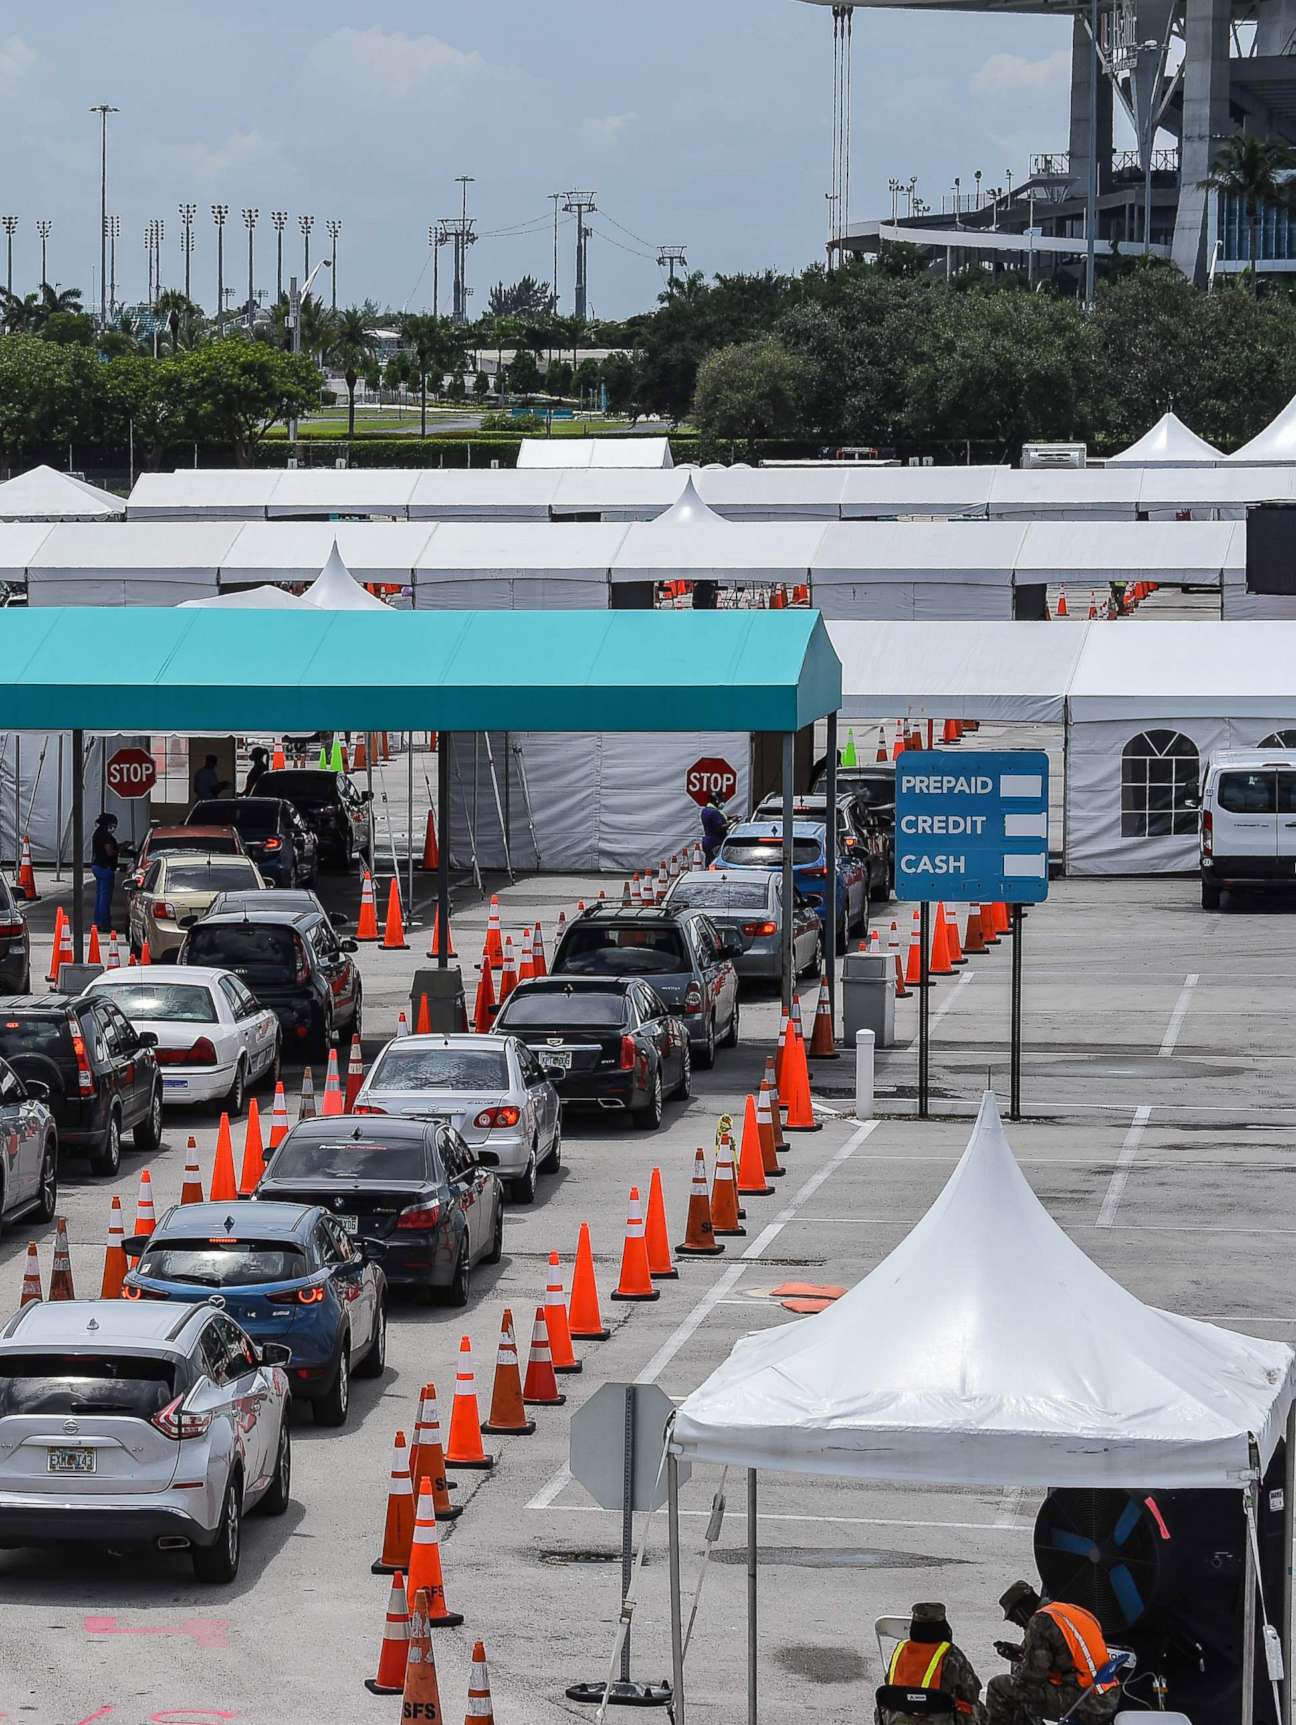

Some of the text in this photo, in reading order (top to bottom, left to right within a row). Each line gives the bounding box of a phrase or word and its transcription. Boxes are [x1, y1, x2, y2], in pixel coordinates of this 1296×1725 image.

[109, 763, 153, 783] STOP
[688, 772, 734, 793] STOP
[901, 775, 993, 795] PREPAID
[900, 815, 987, 835] CREDIT
[900, 854, 966, 874] CASH
[403, 1701, 436, 1720] SFS
